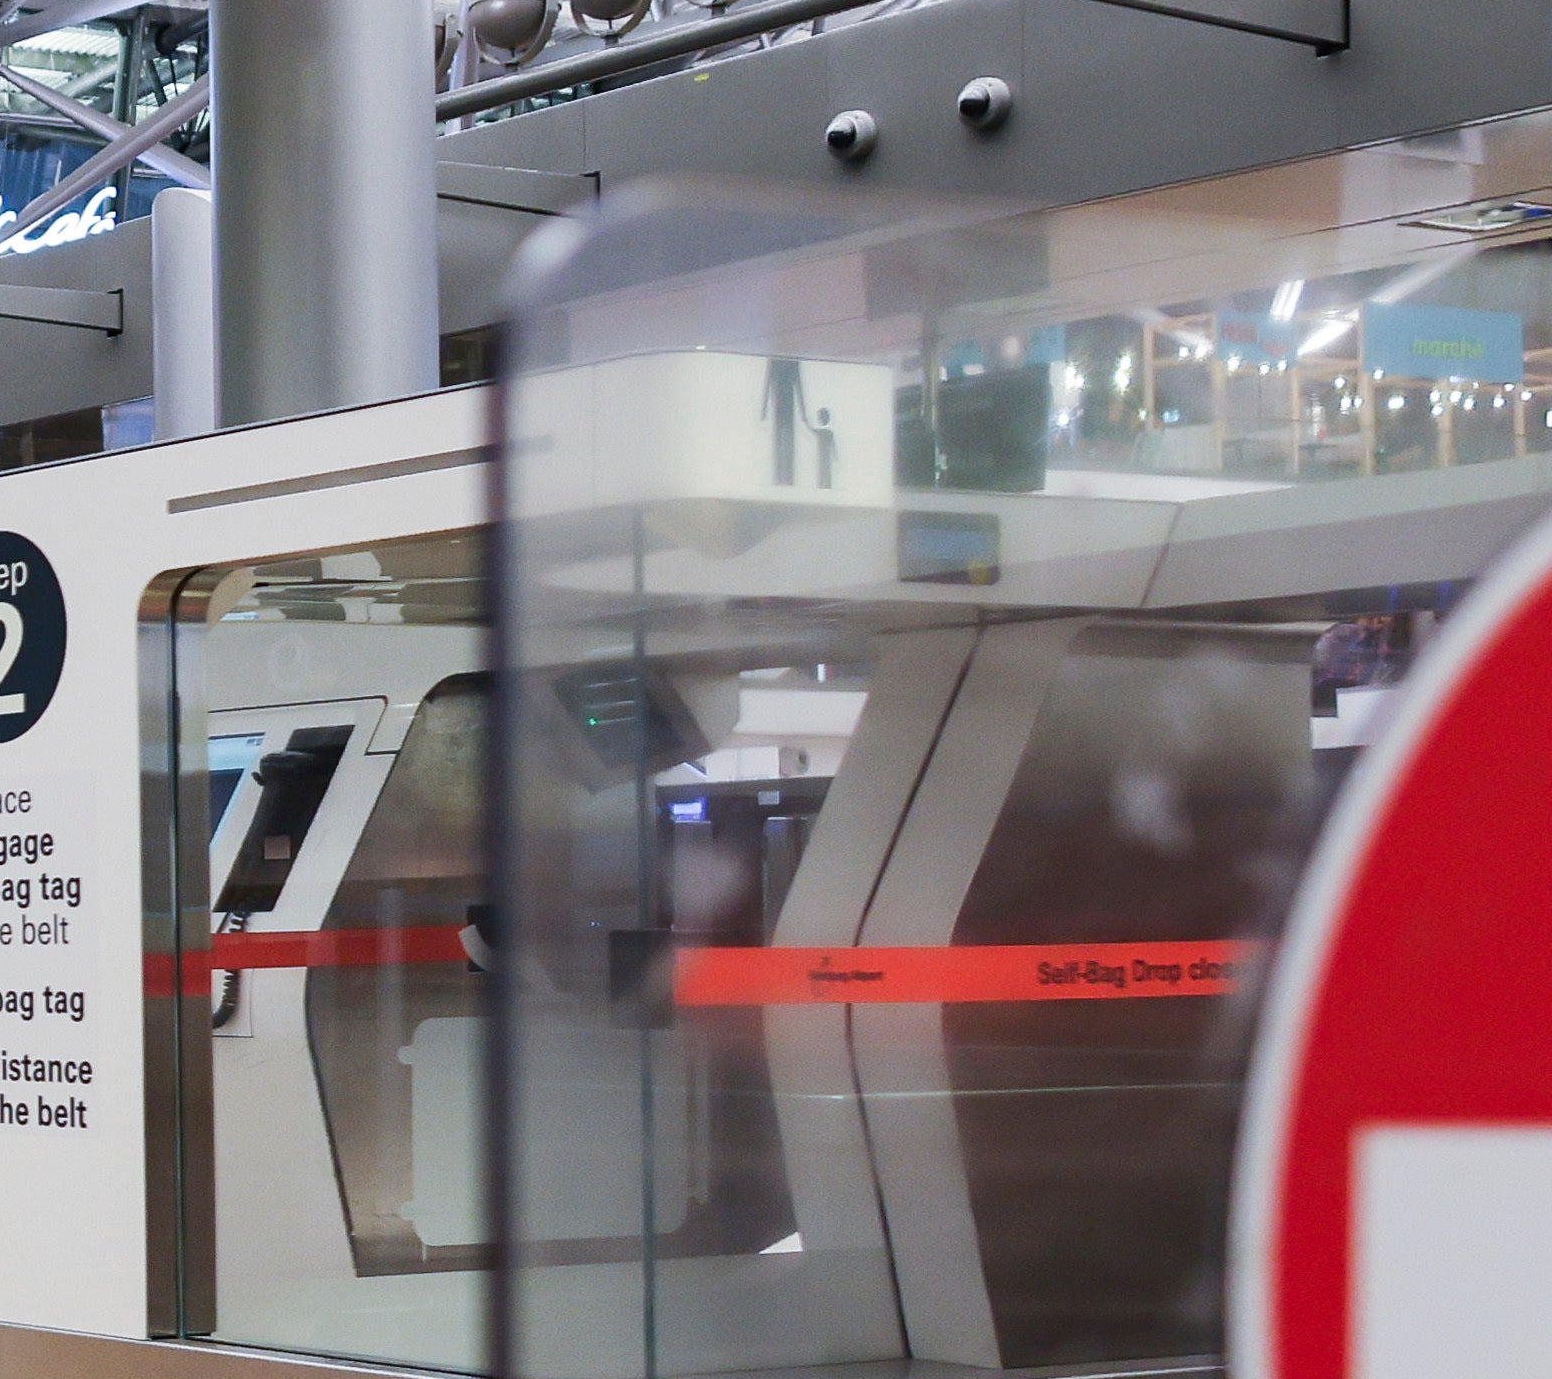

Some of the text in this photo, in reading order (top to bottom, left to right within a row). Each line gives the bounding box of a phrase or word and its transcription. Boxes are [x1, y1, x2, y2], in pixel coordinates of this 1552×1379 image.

[39, 873, 82, 907] tag
[22, 913, 69, 946] belt
[1037, 961, 1126, 988] Self-Bag
[1133, 958, 1182, 986] Drop
[42, 986, 85, 1022] tag
[38, 1095, 87, 1129] belt
